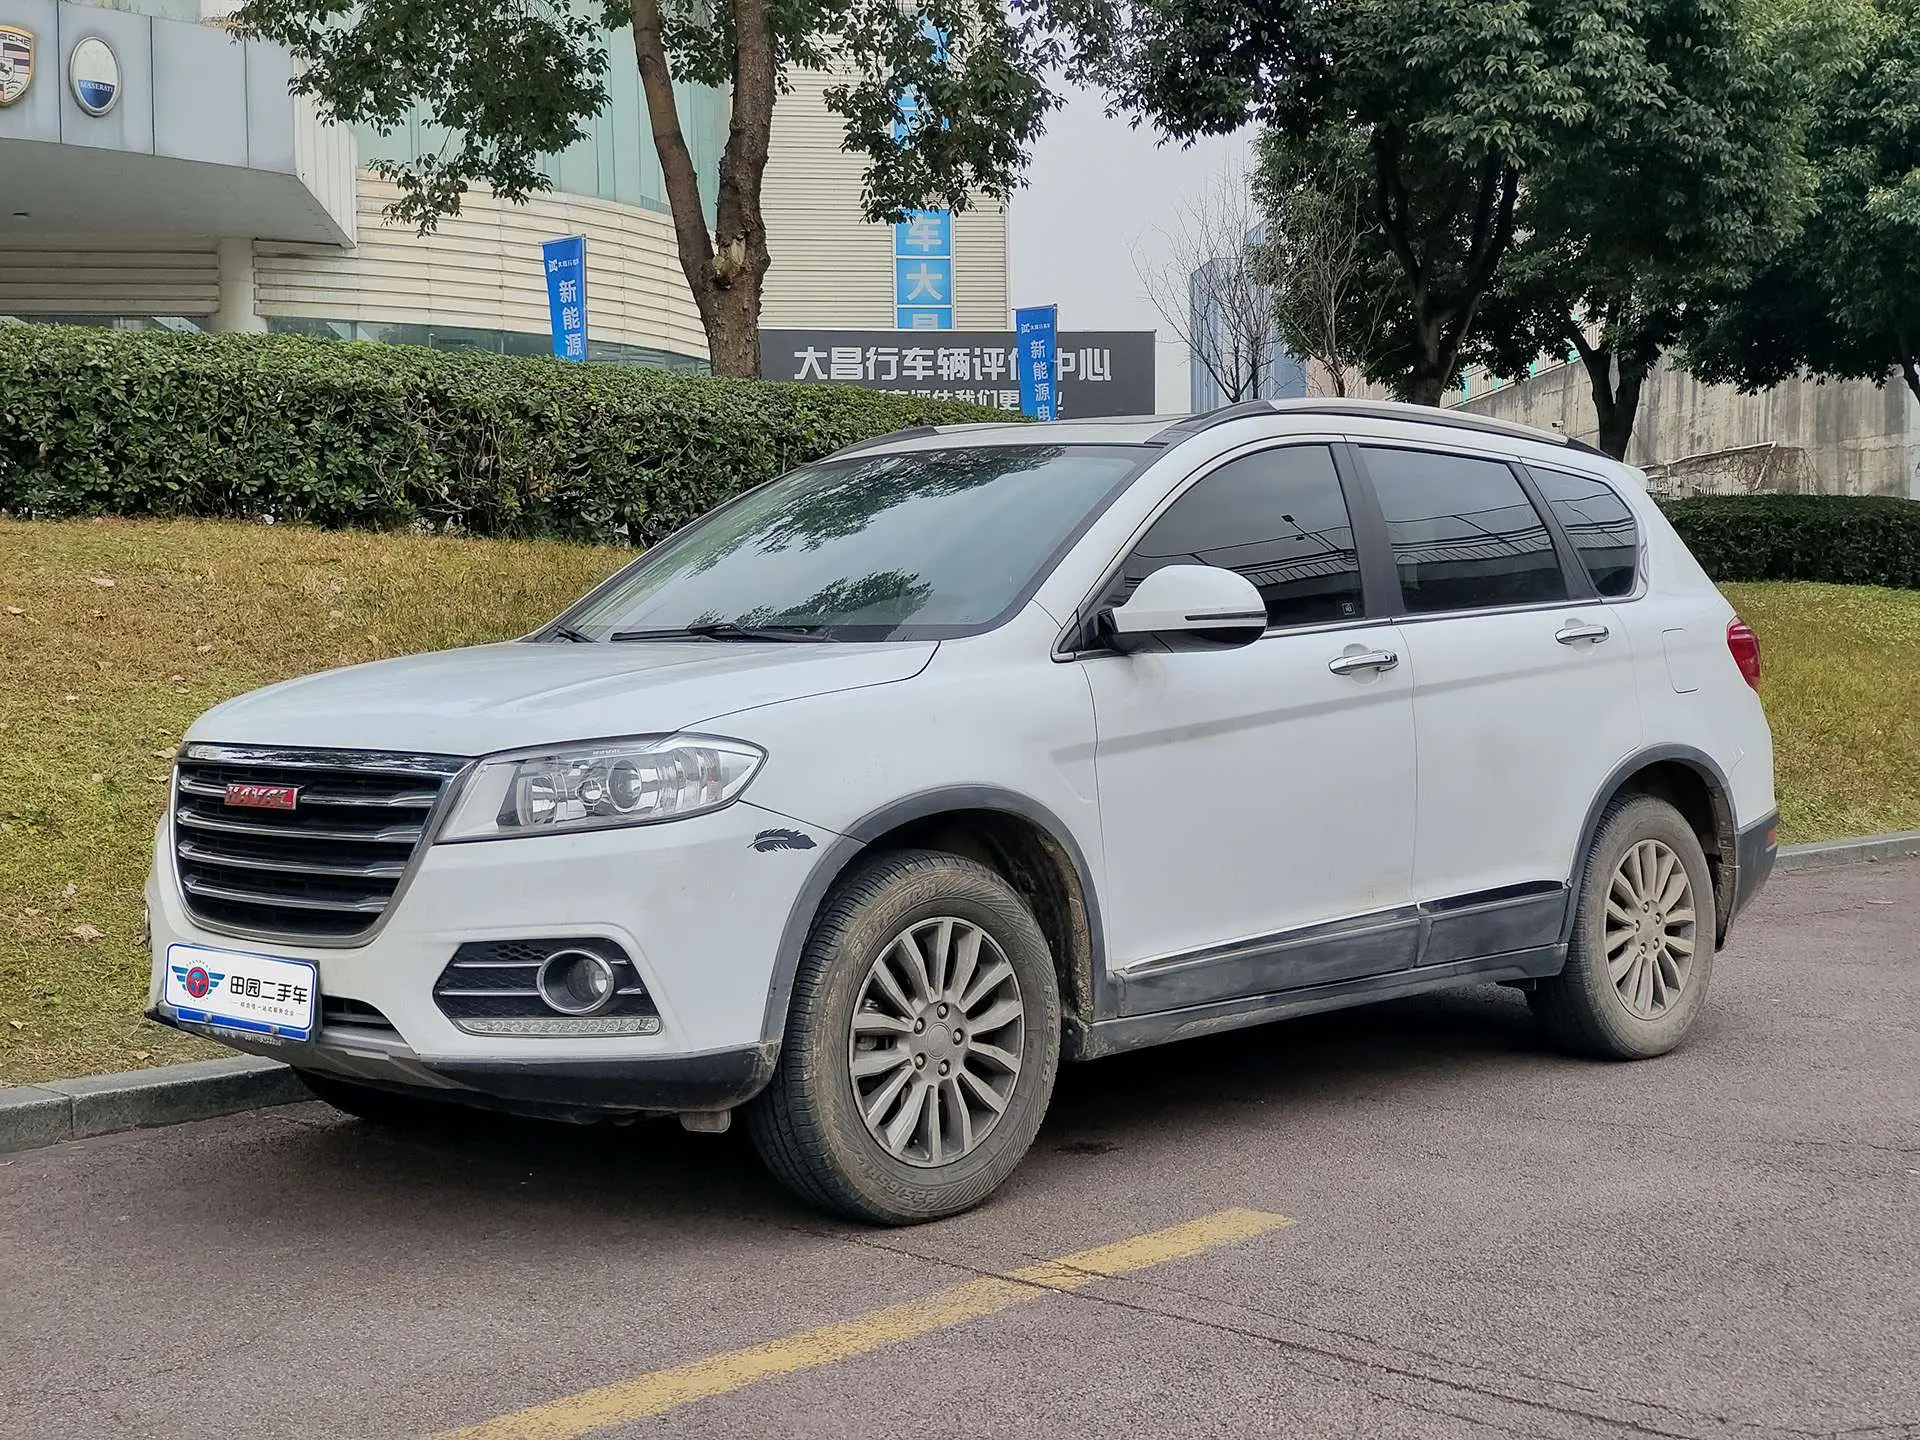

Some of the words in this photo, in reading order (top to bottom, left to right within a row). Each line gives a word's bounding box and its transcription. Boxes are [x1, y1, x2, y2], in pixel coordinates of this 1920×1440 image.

[79, 82, 114, 93] MASERATI
[559, 280, 582, 356] 新能源
[230, 975, 308, 1005] 田园二手车
